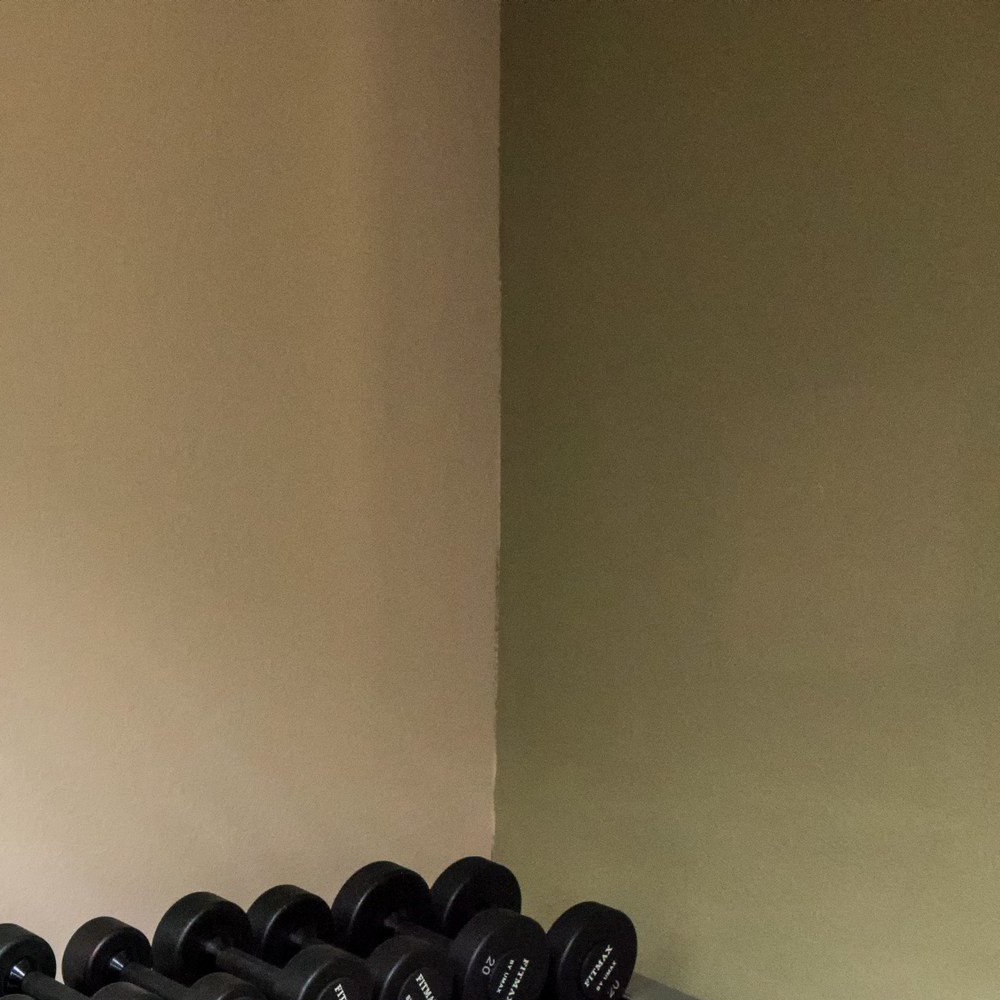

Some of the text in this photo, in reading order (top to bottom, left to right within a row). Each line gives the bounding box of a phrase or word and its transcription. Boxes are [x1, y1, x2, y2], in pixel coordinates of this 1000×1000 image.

[482, 956, 495, 975] 20
[497, 960, 514, 993] BY UMAX
[584, 945, 613, 987] FITMAX
